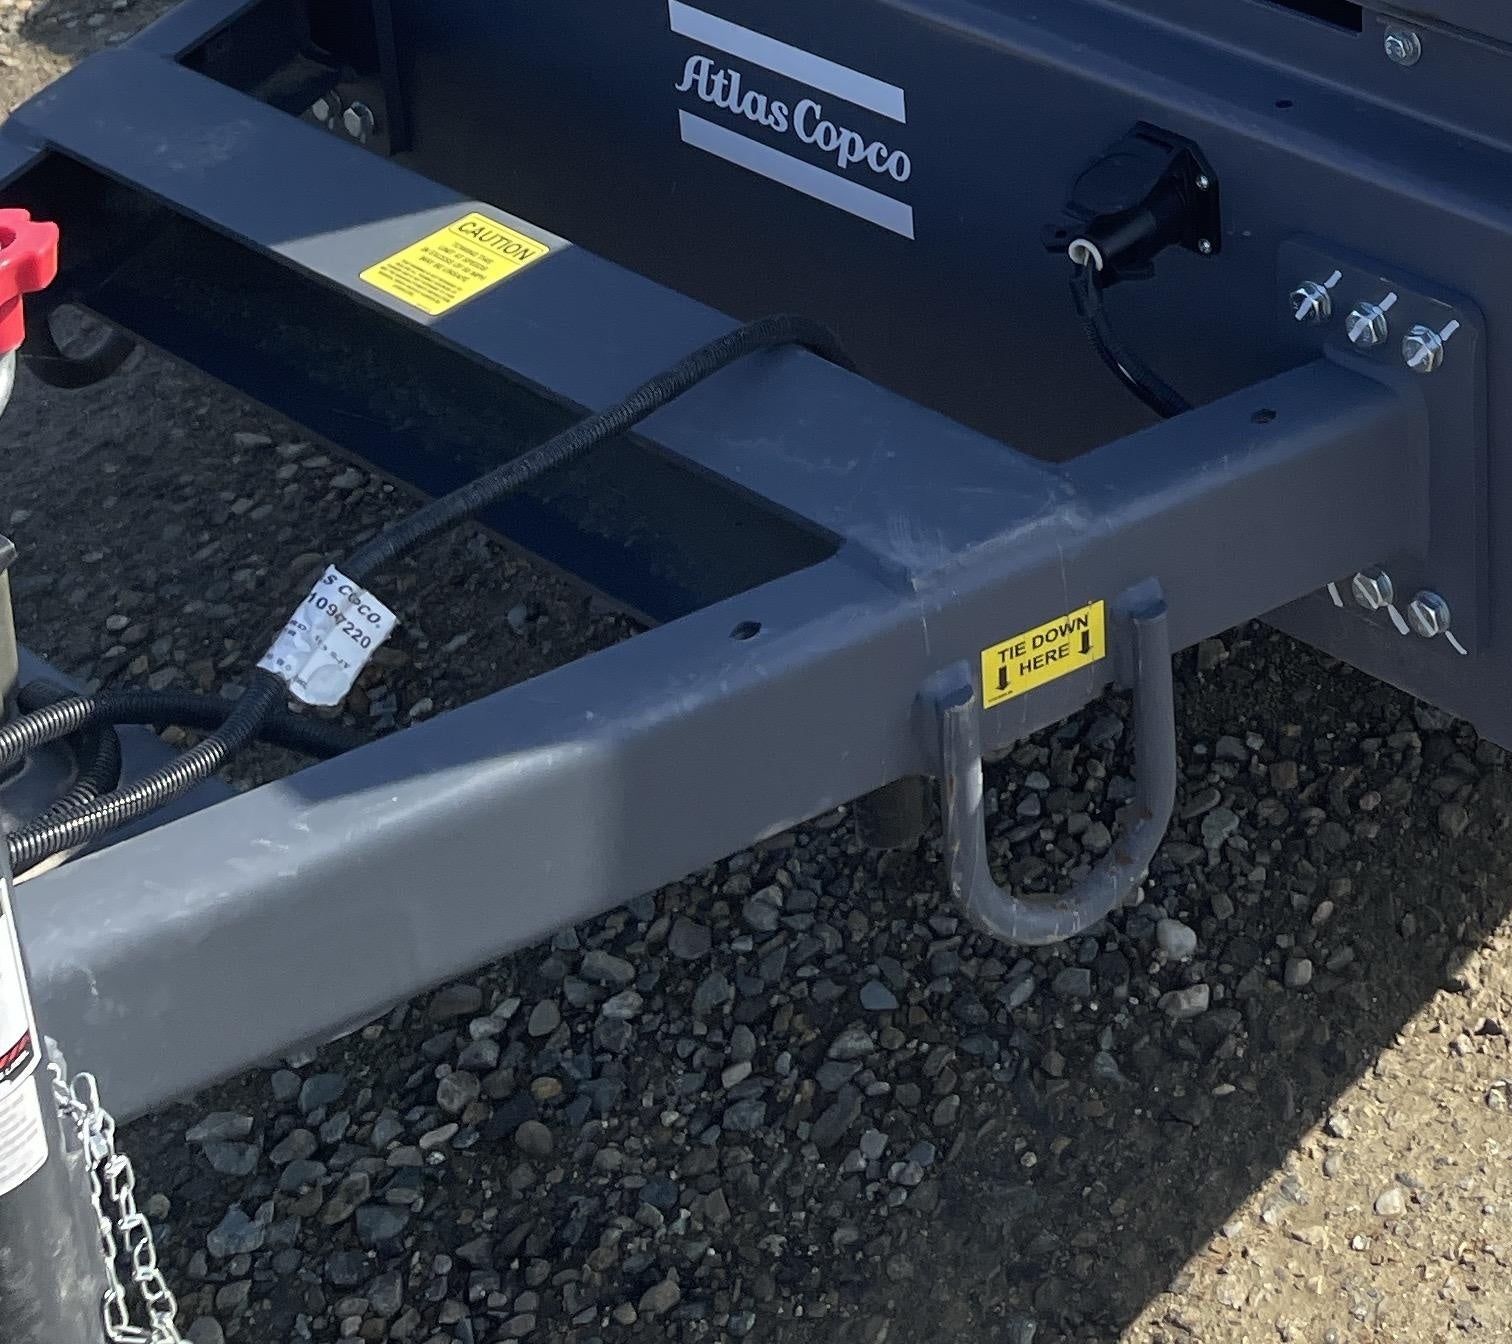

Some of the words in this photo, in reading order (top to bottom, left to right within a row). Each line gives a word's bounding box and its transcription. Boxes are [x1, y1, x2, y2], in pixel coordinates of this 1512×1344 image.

[675, 54, 790, 133] Atlas
[792, 98, 912, 183] Copco
[457, 221, 537, 261] CAUTION
[997, 641, 1027, 664] TIE
[1031, 614, 1090, 650] DOWN
[1019, 643, 1071, 676] HERE
